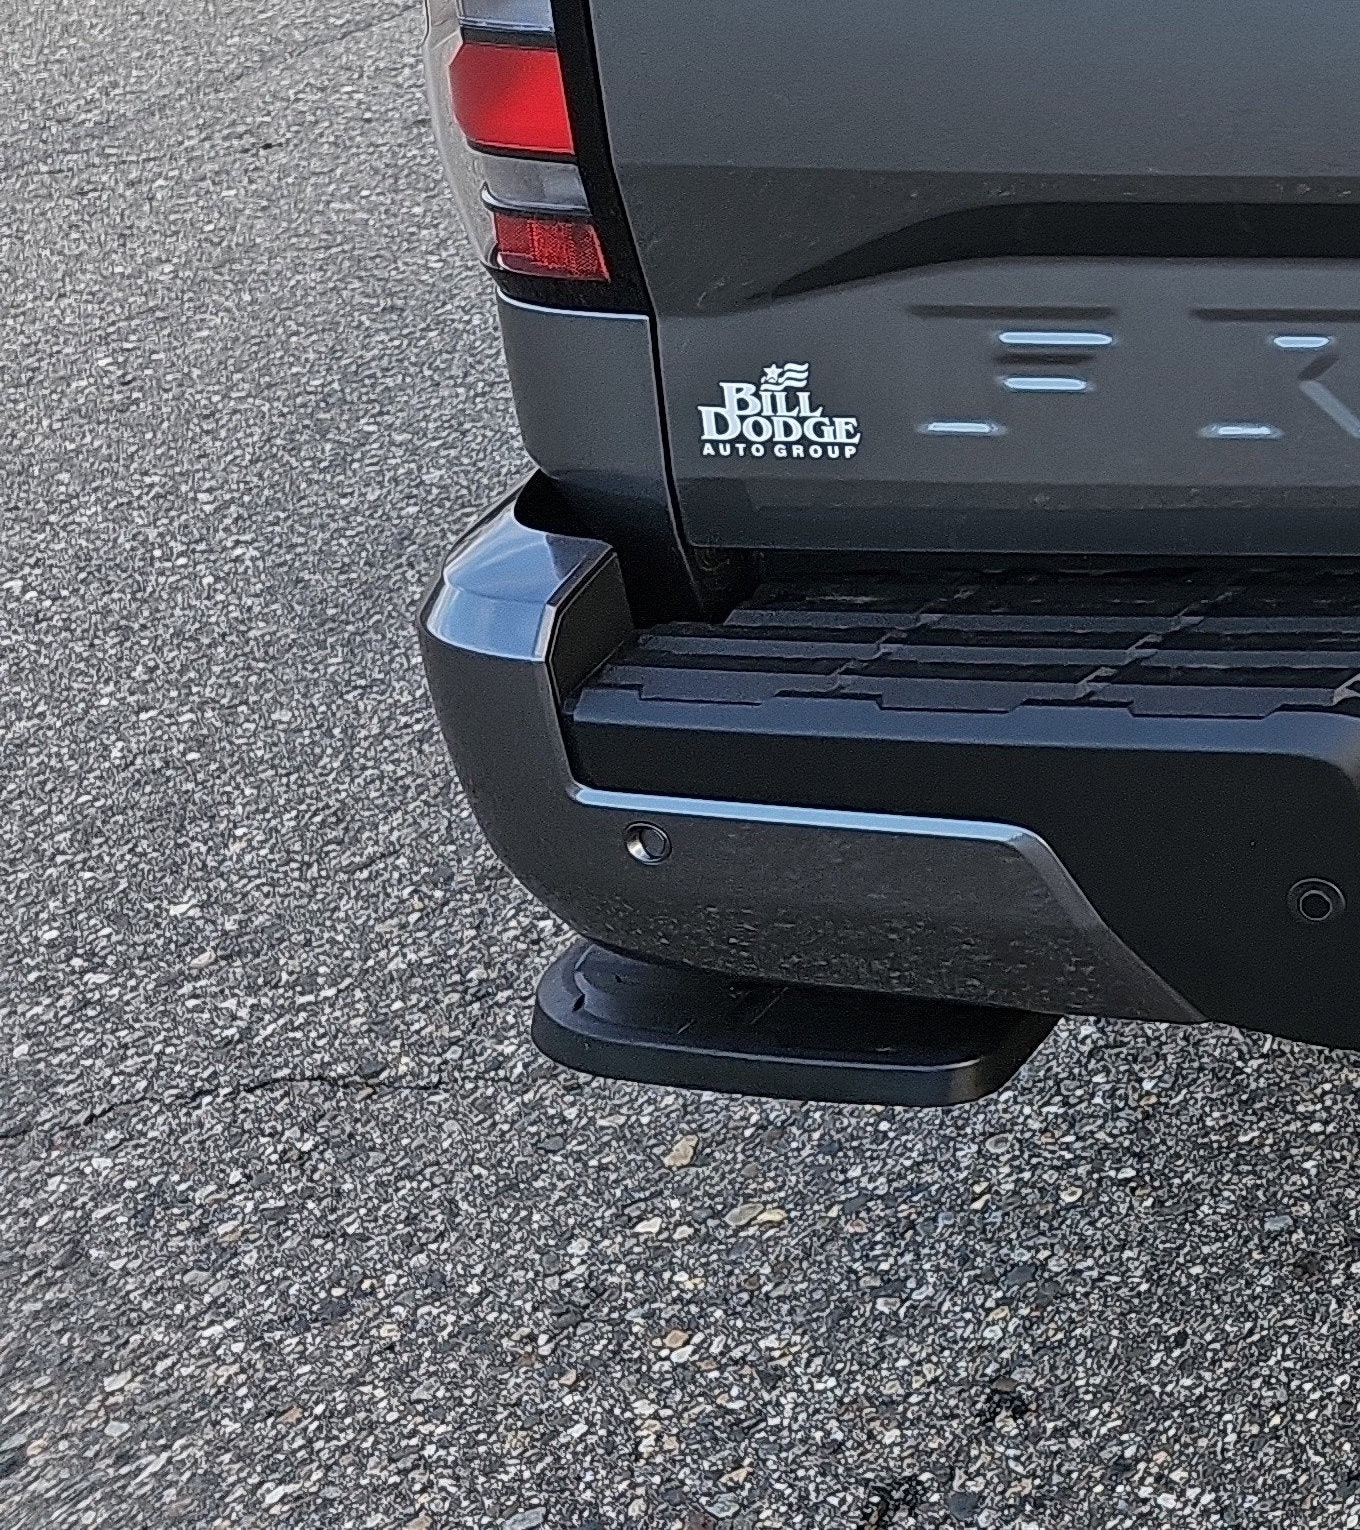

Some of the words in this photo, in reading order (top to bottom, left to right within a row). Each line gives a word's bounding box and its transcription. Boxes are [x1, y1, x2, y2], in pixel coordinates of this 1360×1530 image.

[719, 382, 823, 418] BILL
[697, 405, 861, 444] DODGE
[702, 442, 765, 457] AUTO
[773, 444, 857, 459] GROUP
